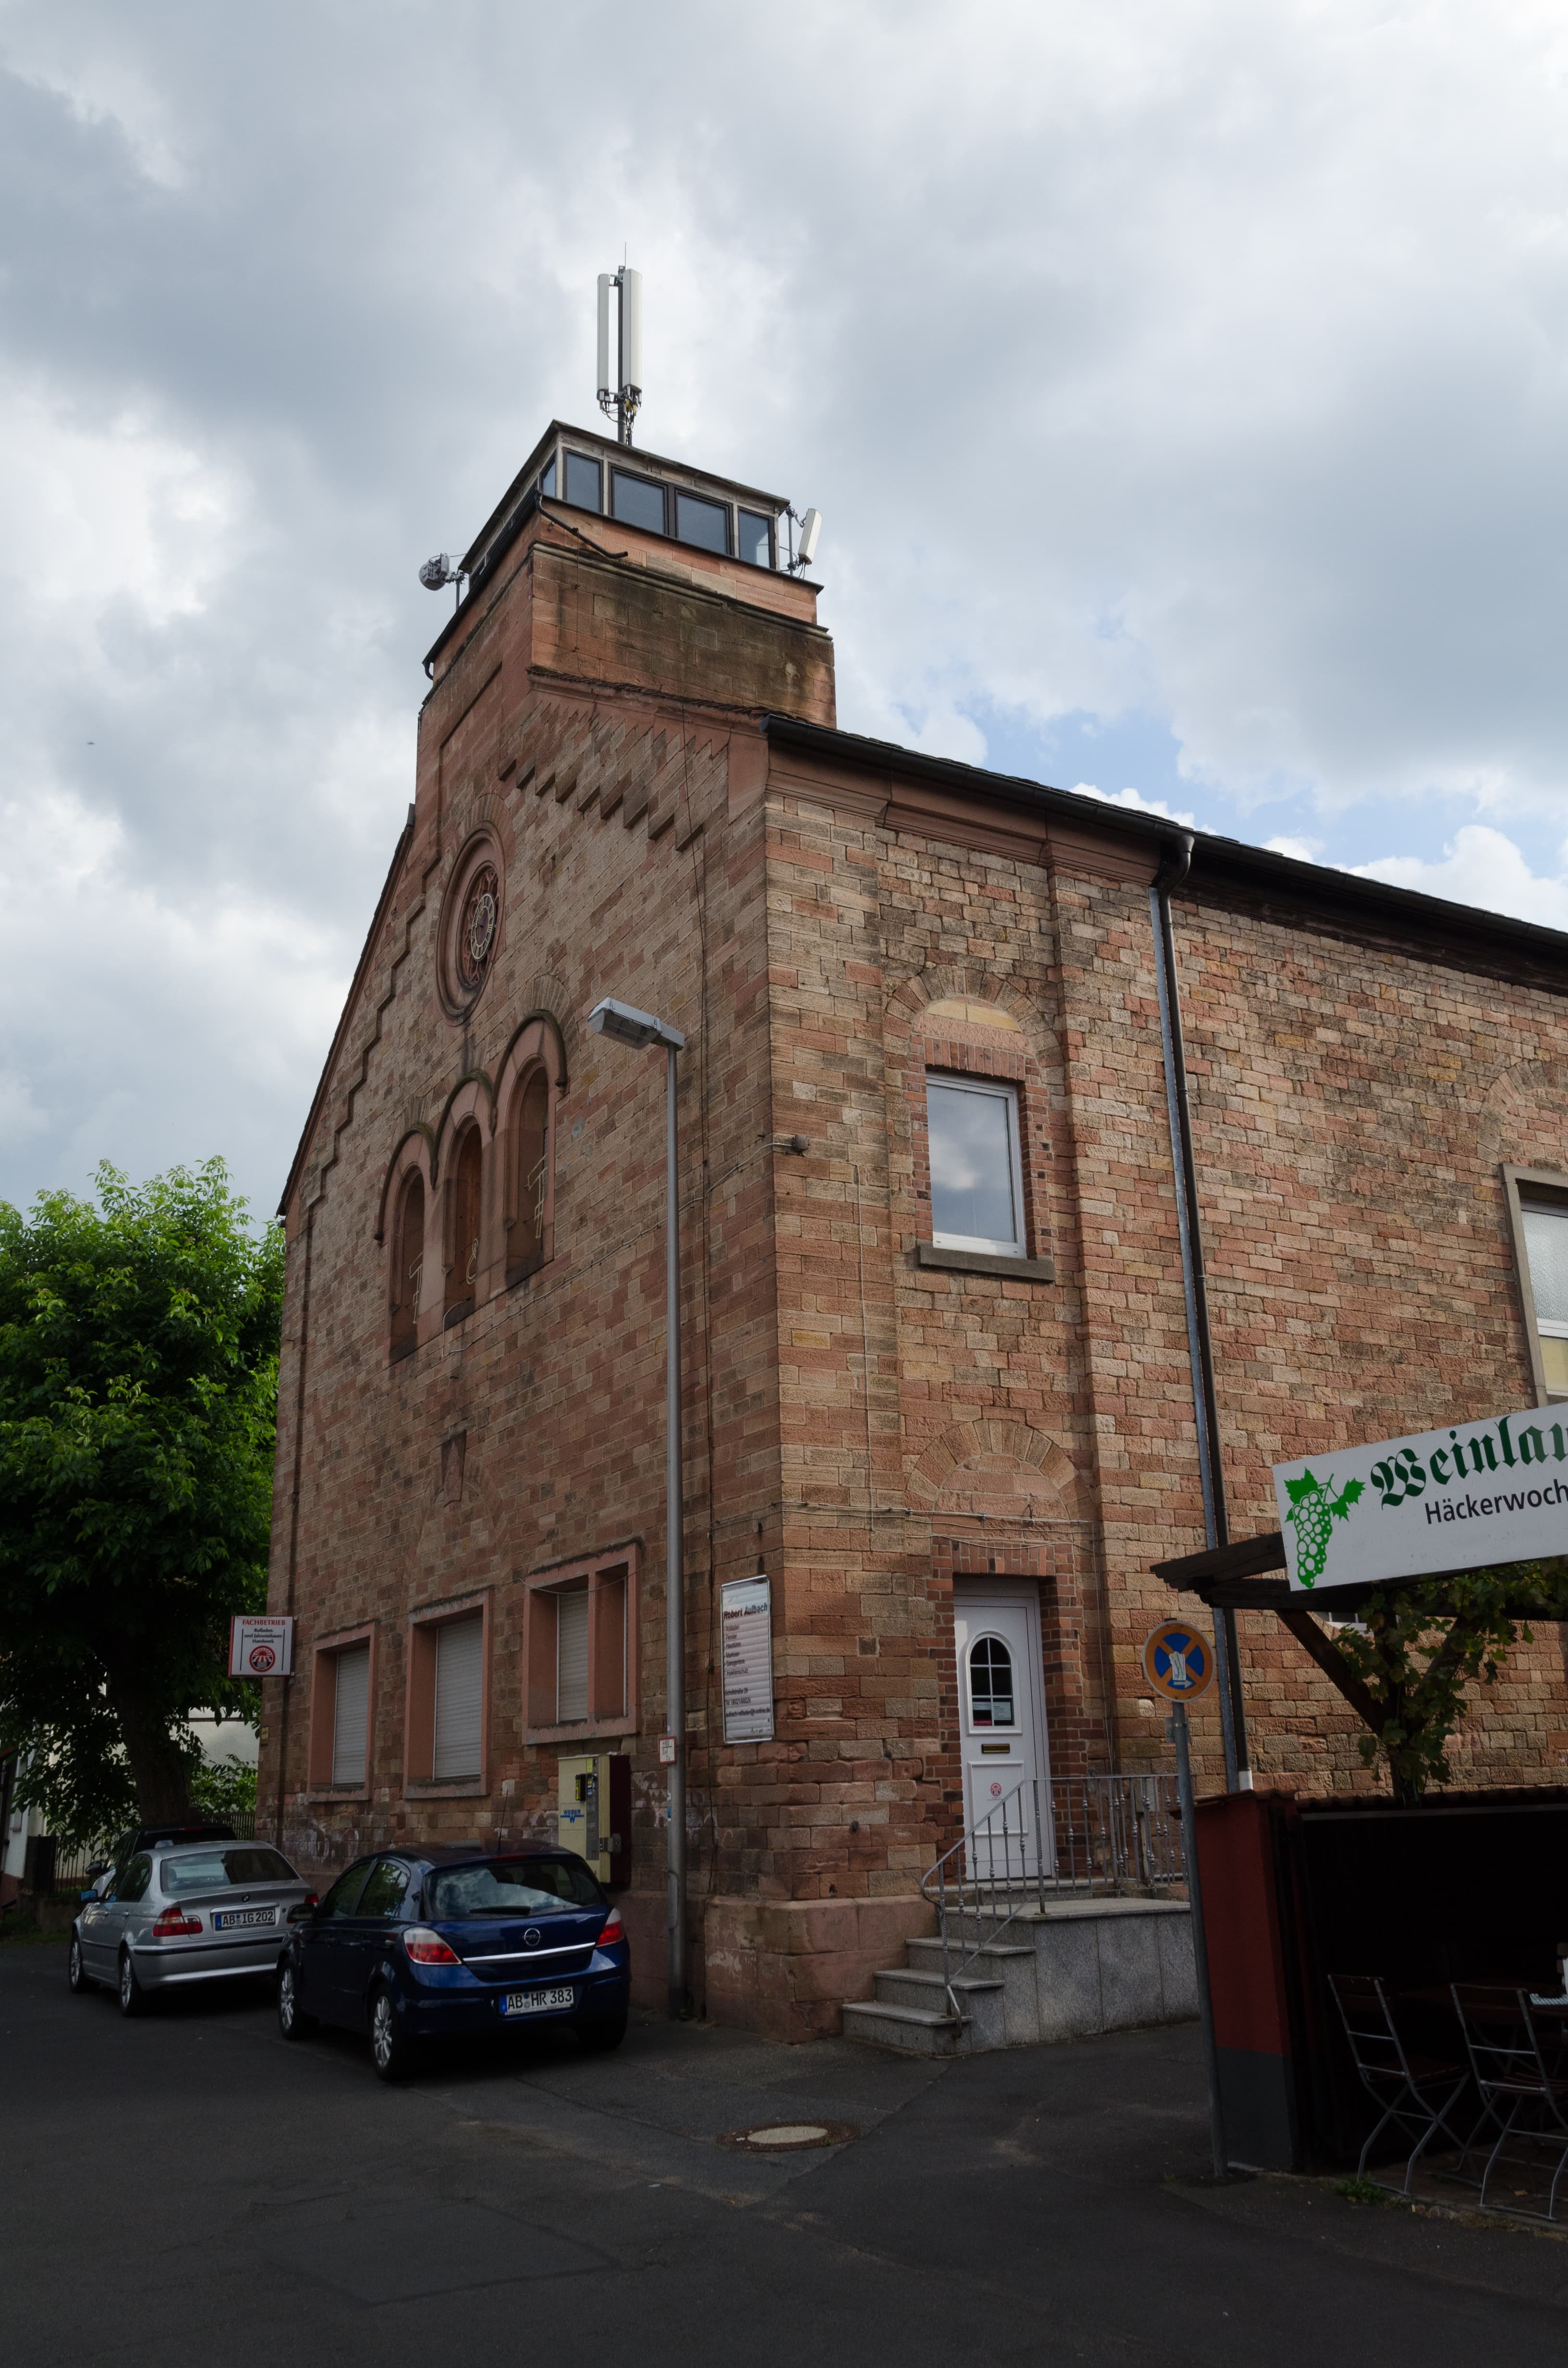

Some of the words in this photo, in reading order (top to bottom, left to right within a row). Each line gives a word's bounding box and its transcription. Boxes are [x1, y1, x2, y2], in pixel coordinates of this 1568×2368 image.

[724, 1608, 743, 1619] Robert
[744, 1602, 768, 1616] Aulbach
[223, 1915, 235, 1925] AB
[243, 1913, 254, 1924] IG
[256, 1912, 273, 1923] 202
[508, 1995, 523, 2010] AB
[531, 1992, 547, 2007] HR
[551, 1988, 572, 2004] 383
